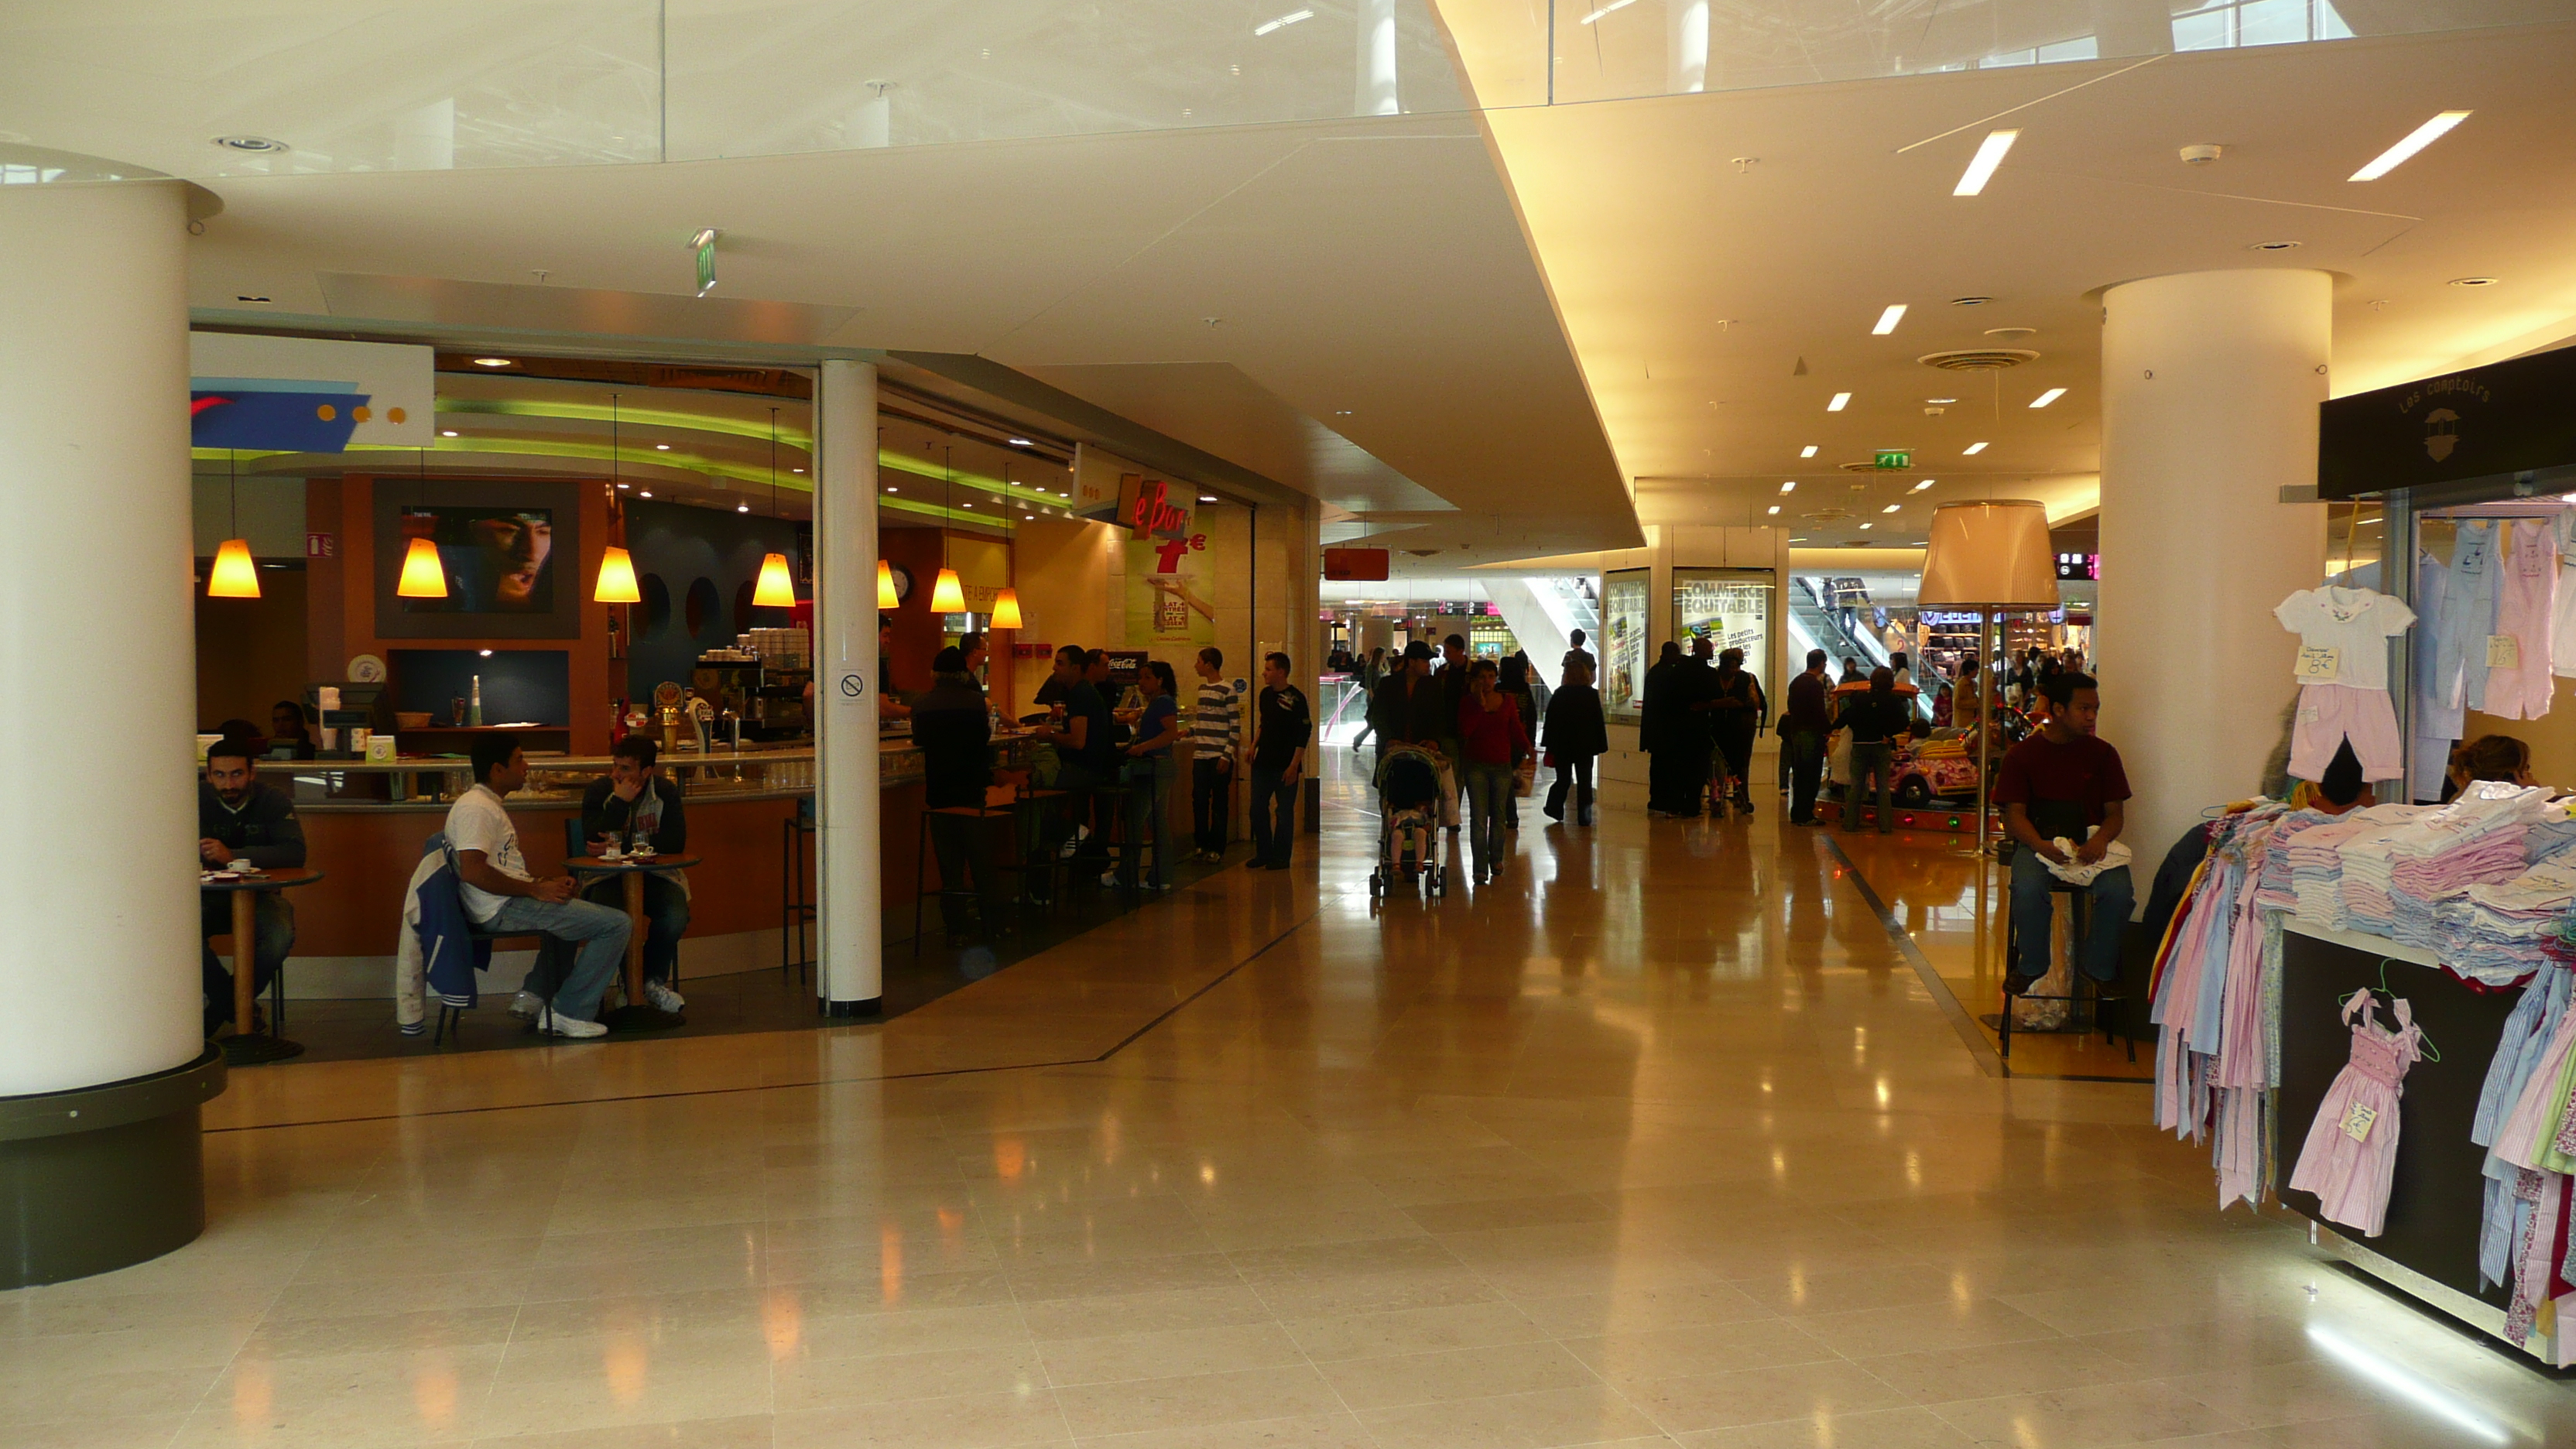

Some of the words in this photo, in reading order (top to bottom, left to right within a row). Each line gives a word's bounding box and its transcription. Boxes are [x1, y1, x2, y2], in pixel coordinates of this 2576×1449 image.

[2426, 376, 2492, 403] comptoirs
[1684, 583, 1764, 598] COMMERCE
[1728, 633, 1763, 649] producteurs
